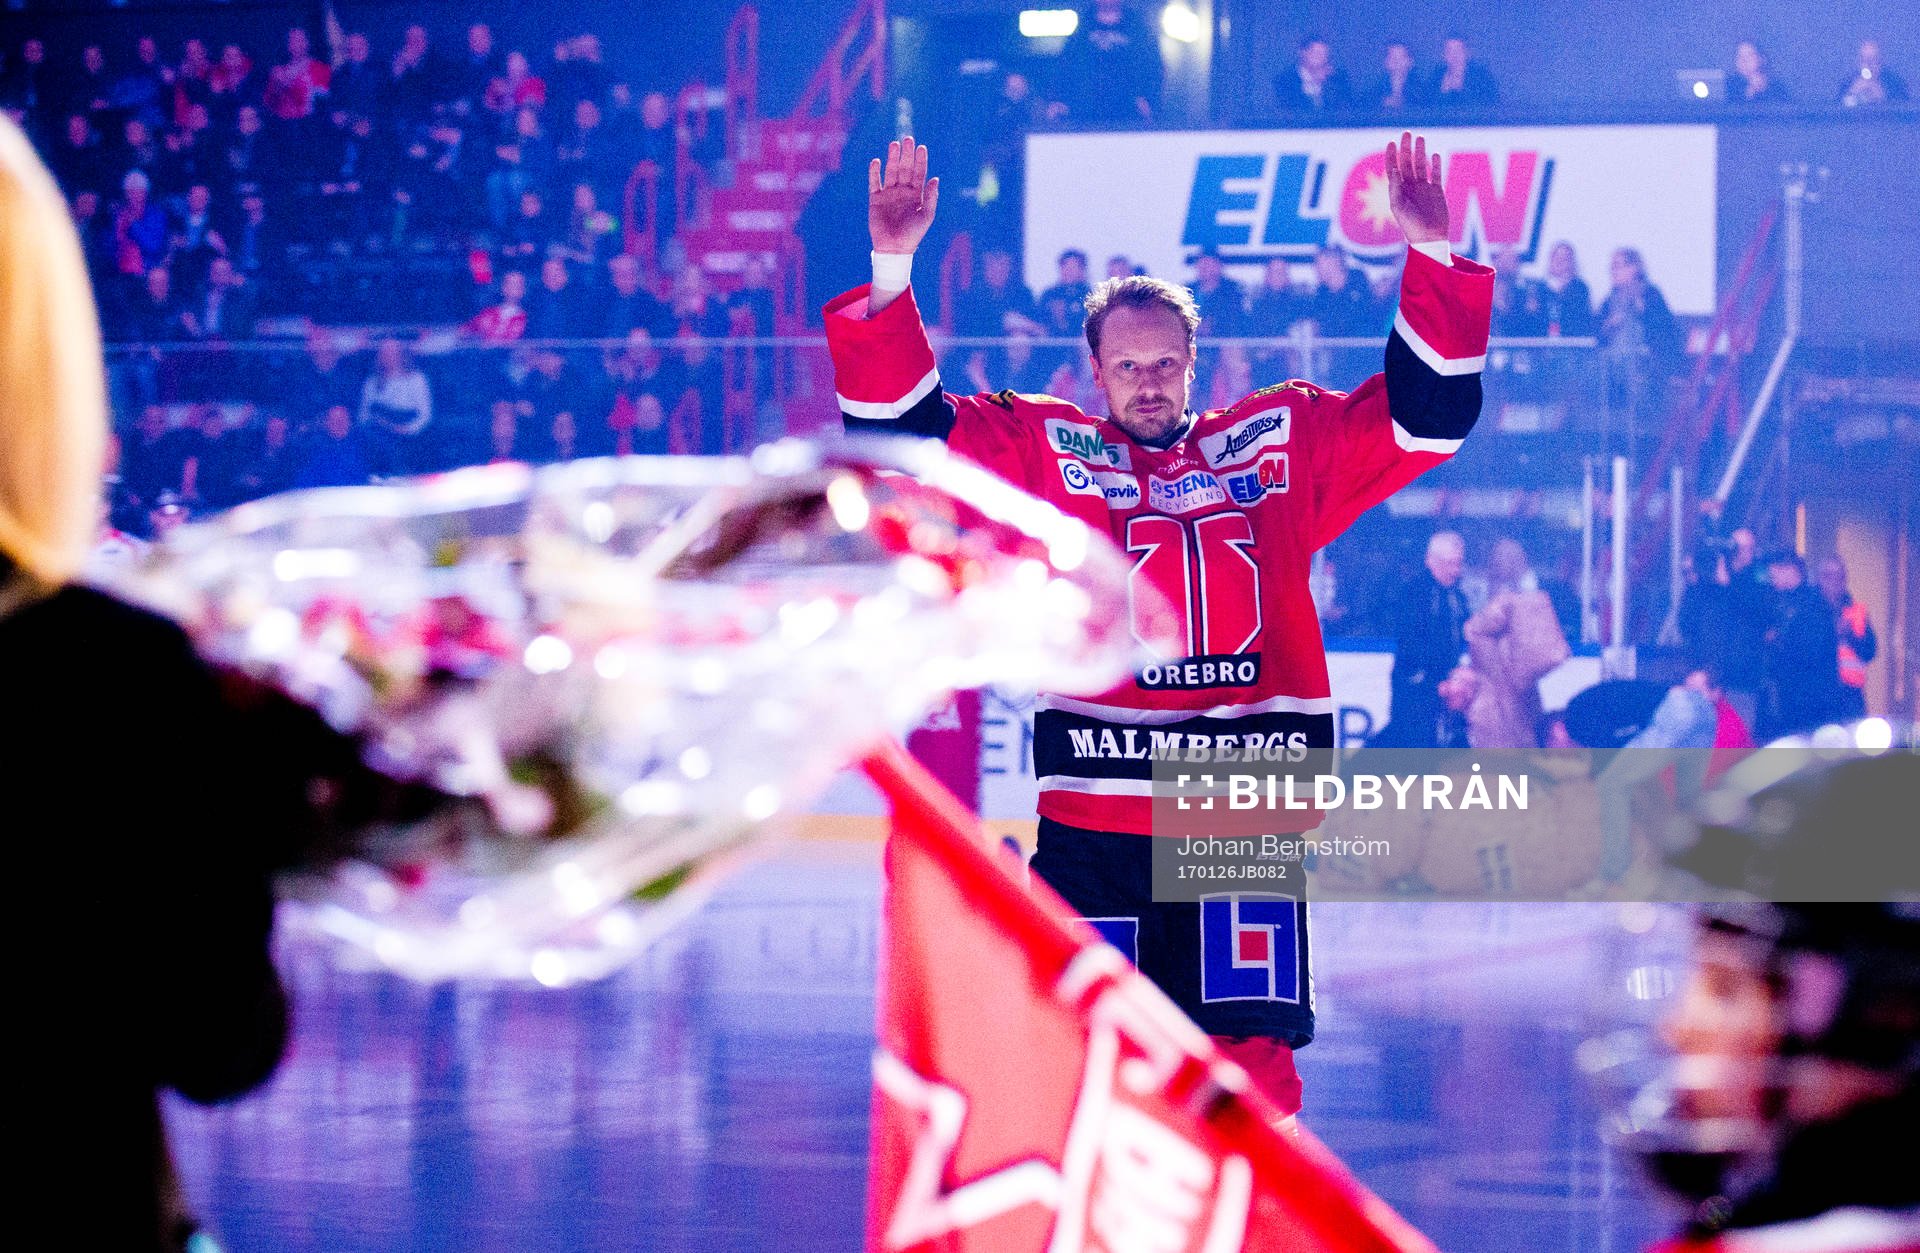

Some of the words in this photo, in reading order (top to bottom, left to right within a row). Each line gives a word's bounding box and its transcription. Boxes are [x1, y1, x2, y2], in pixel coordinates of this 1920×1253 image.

[1180, 150, 1553, 264] ELON
[1150, 490, 1223, 511] RECYCLING
[1164, 473, 1219, 498] STENA
[1068, 728, 1308, 763] MALMBERGS
